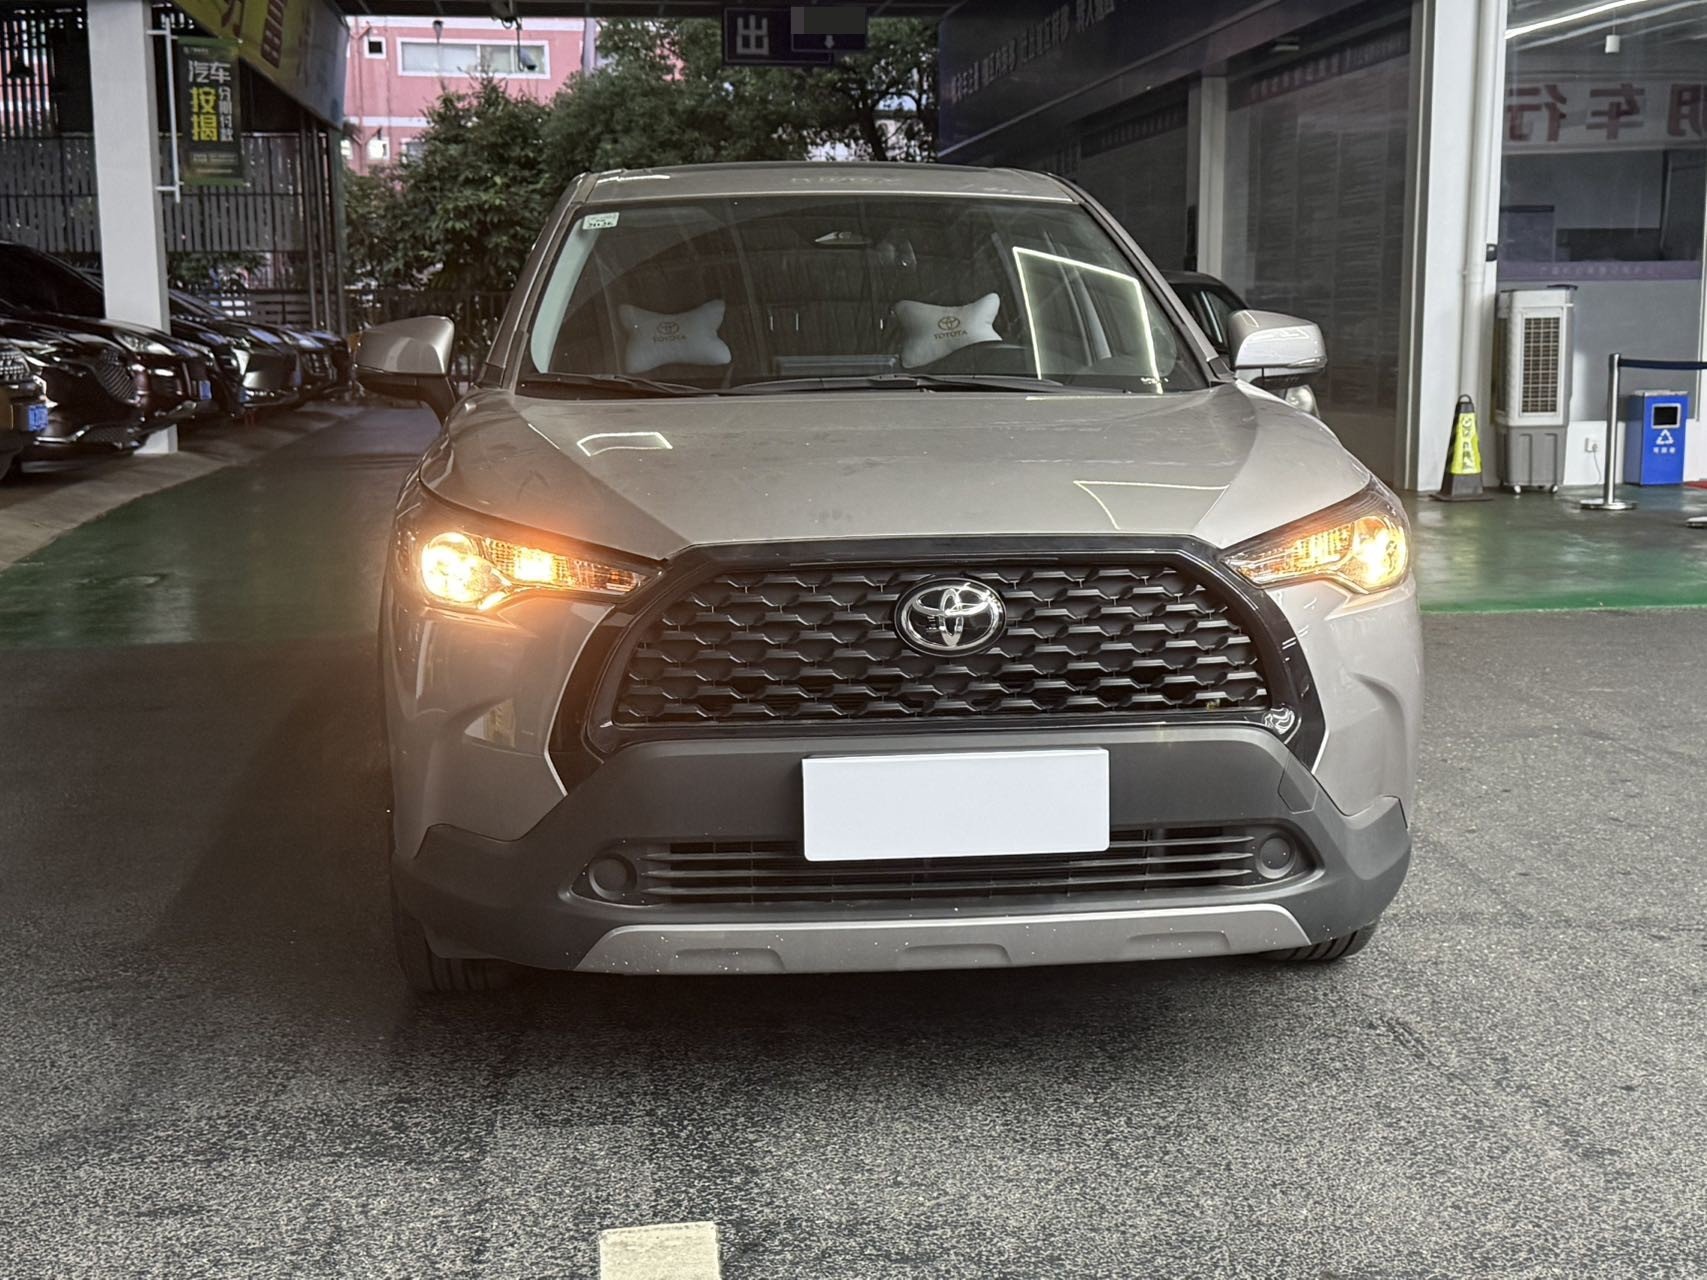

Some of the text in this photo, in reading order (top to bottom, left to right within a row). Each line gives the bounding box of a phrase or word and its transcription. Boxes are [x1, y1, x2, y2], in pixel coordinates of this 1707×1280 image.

[736, 14, 769, 56] 出
[188, 60, 232, 83] 汽车
[189, 87, 218, 141] 按揭
[933, 330, 968, 341] TOYOTA
